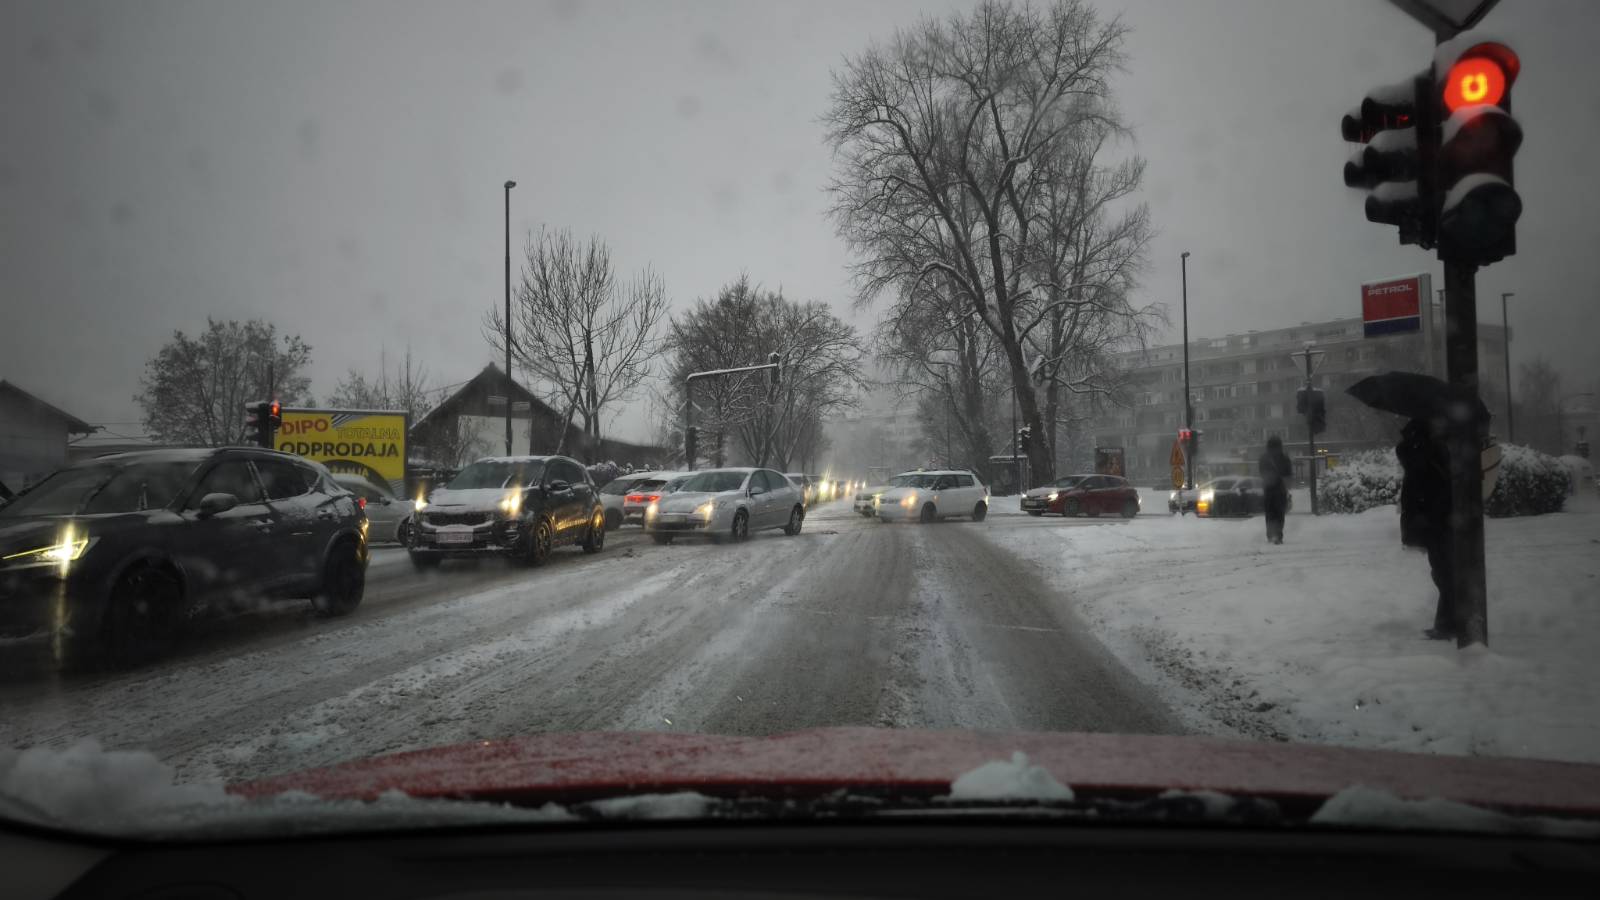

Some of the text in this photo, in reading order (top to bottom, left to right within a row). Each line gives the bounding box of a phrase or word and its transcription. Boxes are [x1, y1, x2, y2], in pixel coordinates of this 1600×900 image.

[1367, 284, 1413, 296] PETROL
[281, 418, 329, 435] DIPO
[336, 427, 400, 440] TOTALNA
[280, 442, 399, 457] ODPRODAJA
